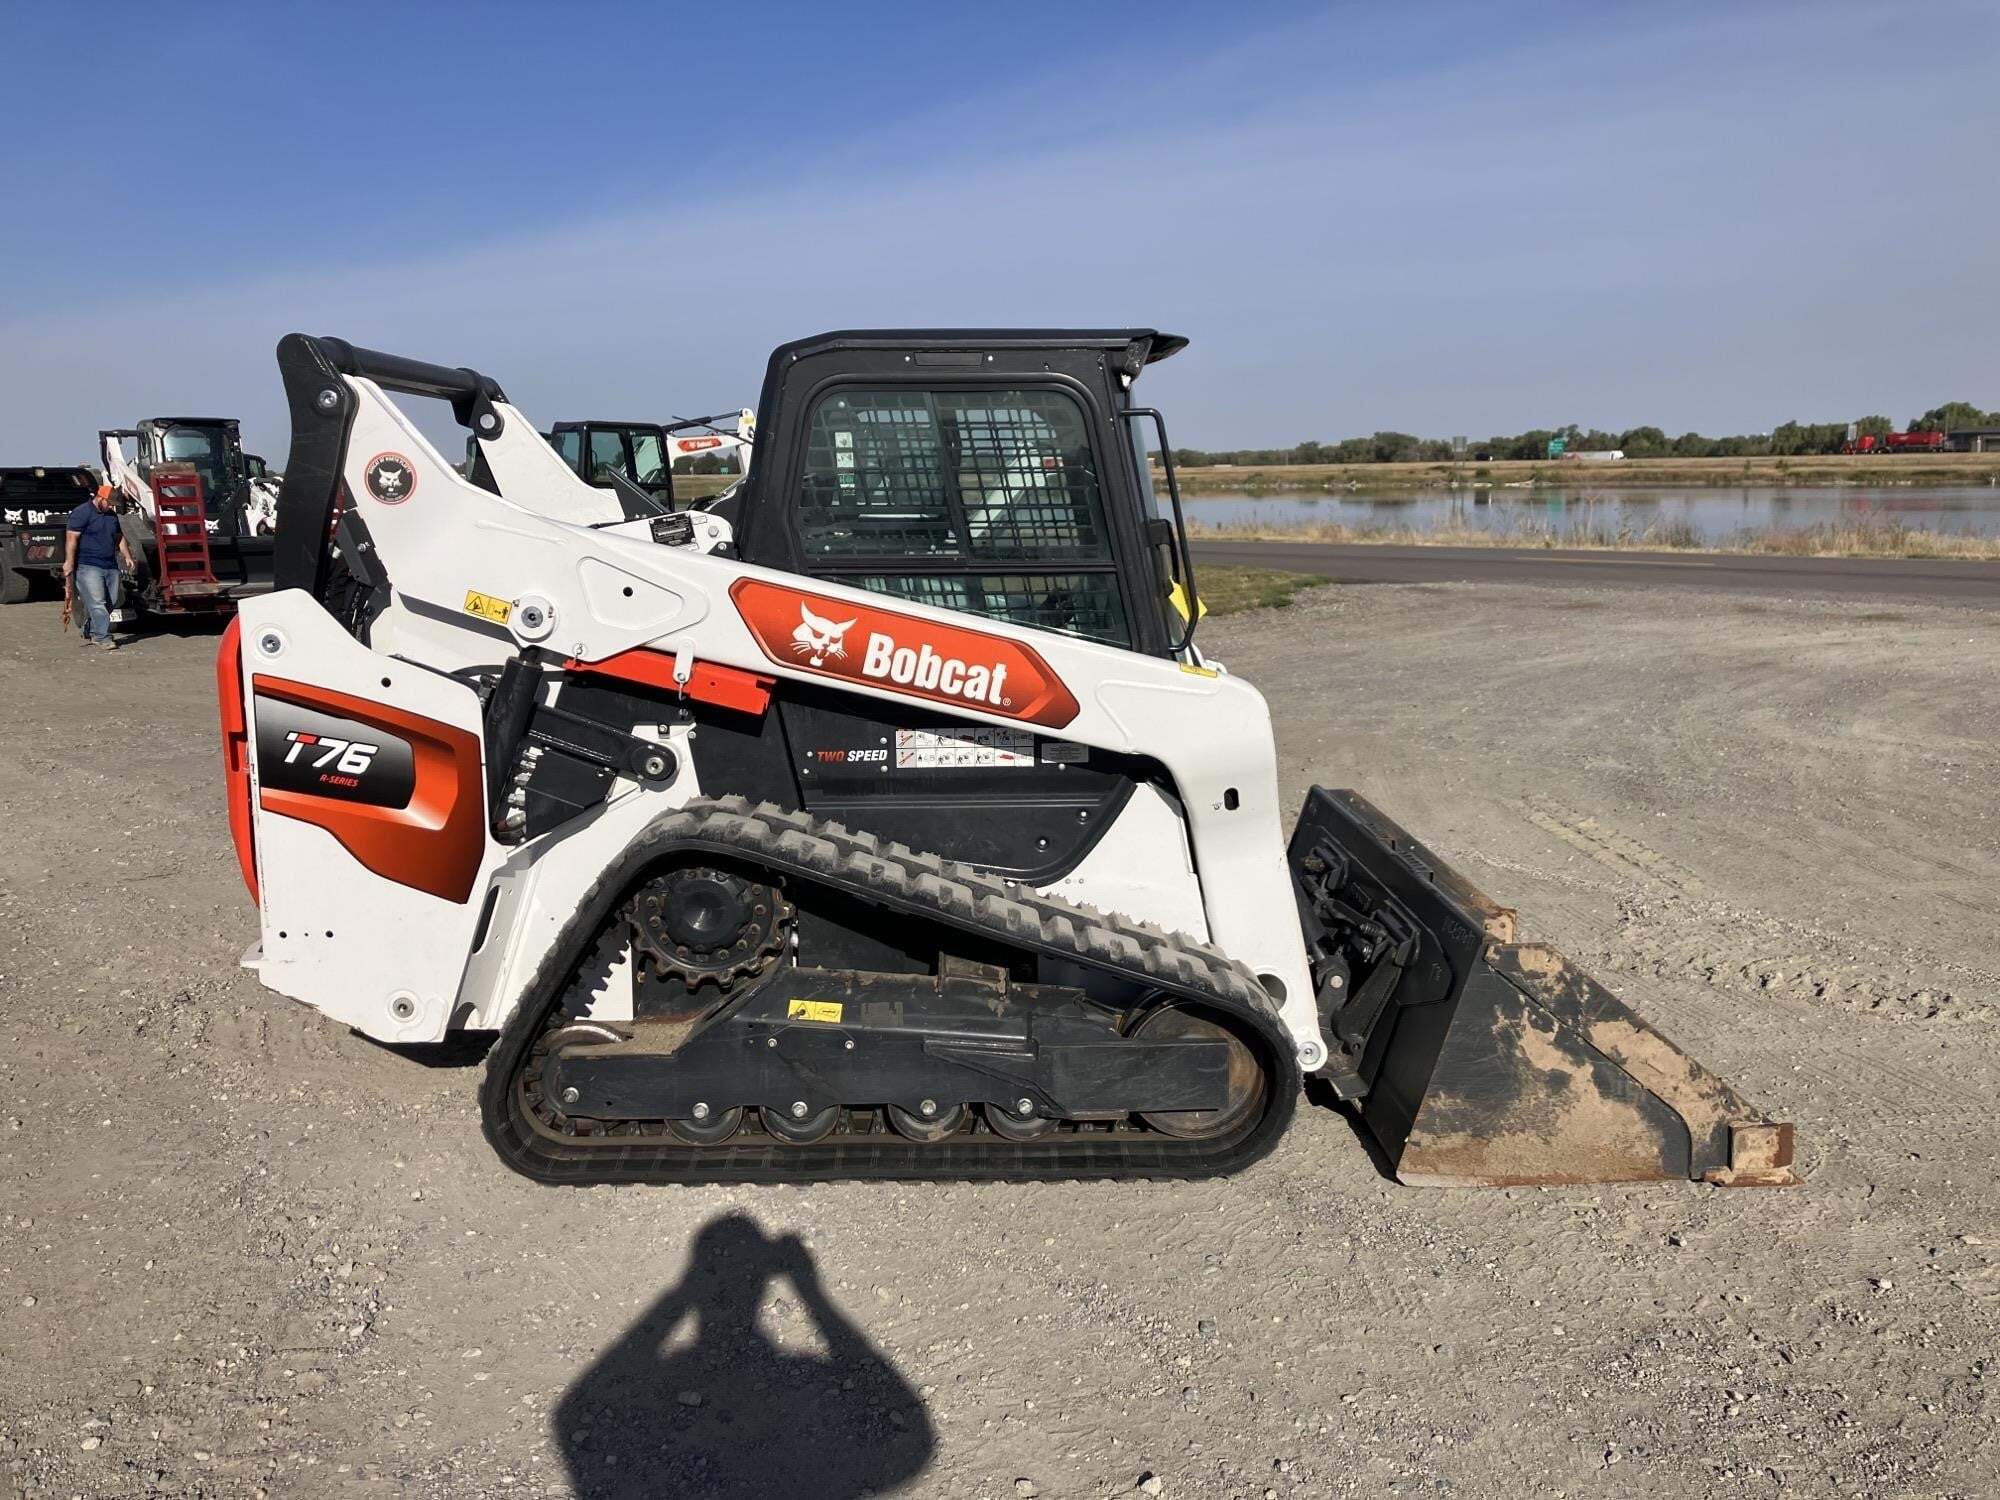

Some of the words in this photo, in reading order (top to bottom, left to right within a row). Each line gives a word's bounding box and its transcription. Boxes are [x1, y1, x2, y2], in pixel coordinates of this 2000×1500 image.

[862, 632, 1007, 704] Bobcat
[284, 732, 379, 774] T76
[817, 751, 845, 762] TWO
[847, 749, 888, 762] SPEED
[319, 774, 359, 787] R-SERIES
